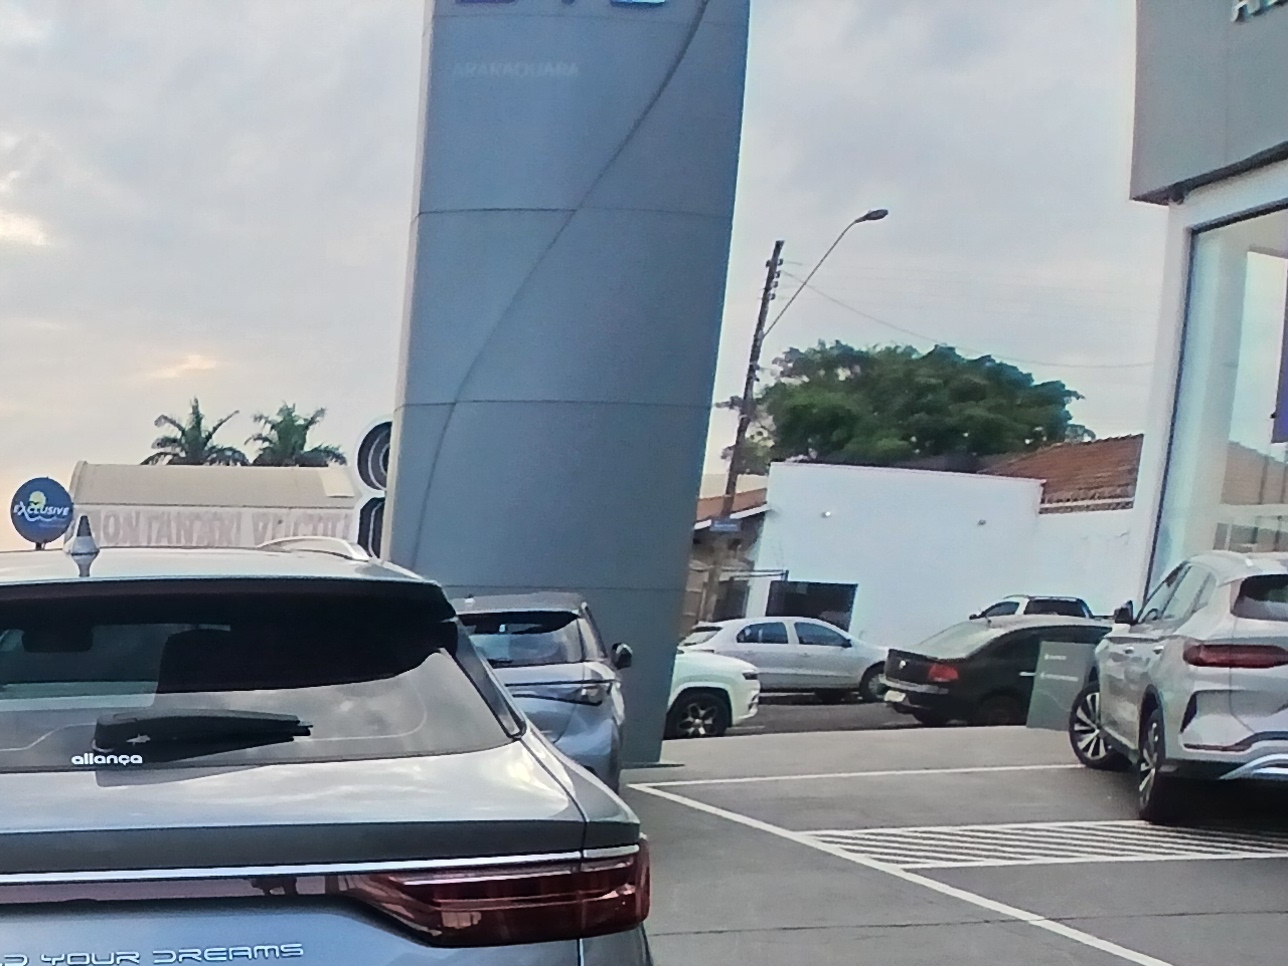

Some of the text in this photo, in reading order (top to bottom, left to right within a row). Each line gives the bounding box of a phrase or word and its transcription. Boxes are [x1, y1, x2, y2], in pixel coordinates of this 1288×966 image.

[13, 501, 70, 516] EXCLUSIVE
[71, 753, 143, 766] aliança
[40, 950, 142, 966] YOUR
[152, 942, 305, 965] DREAMS
